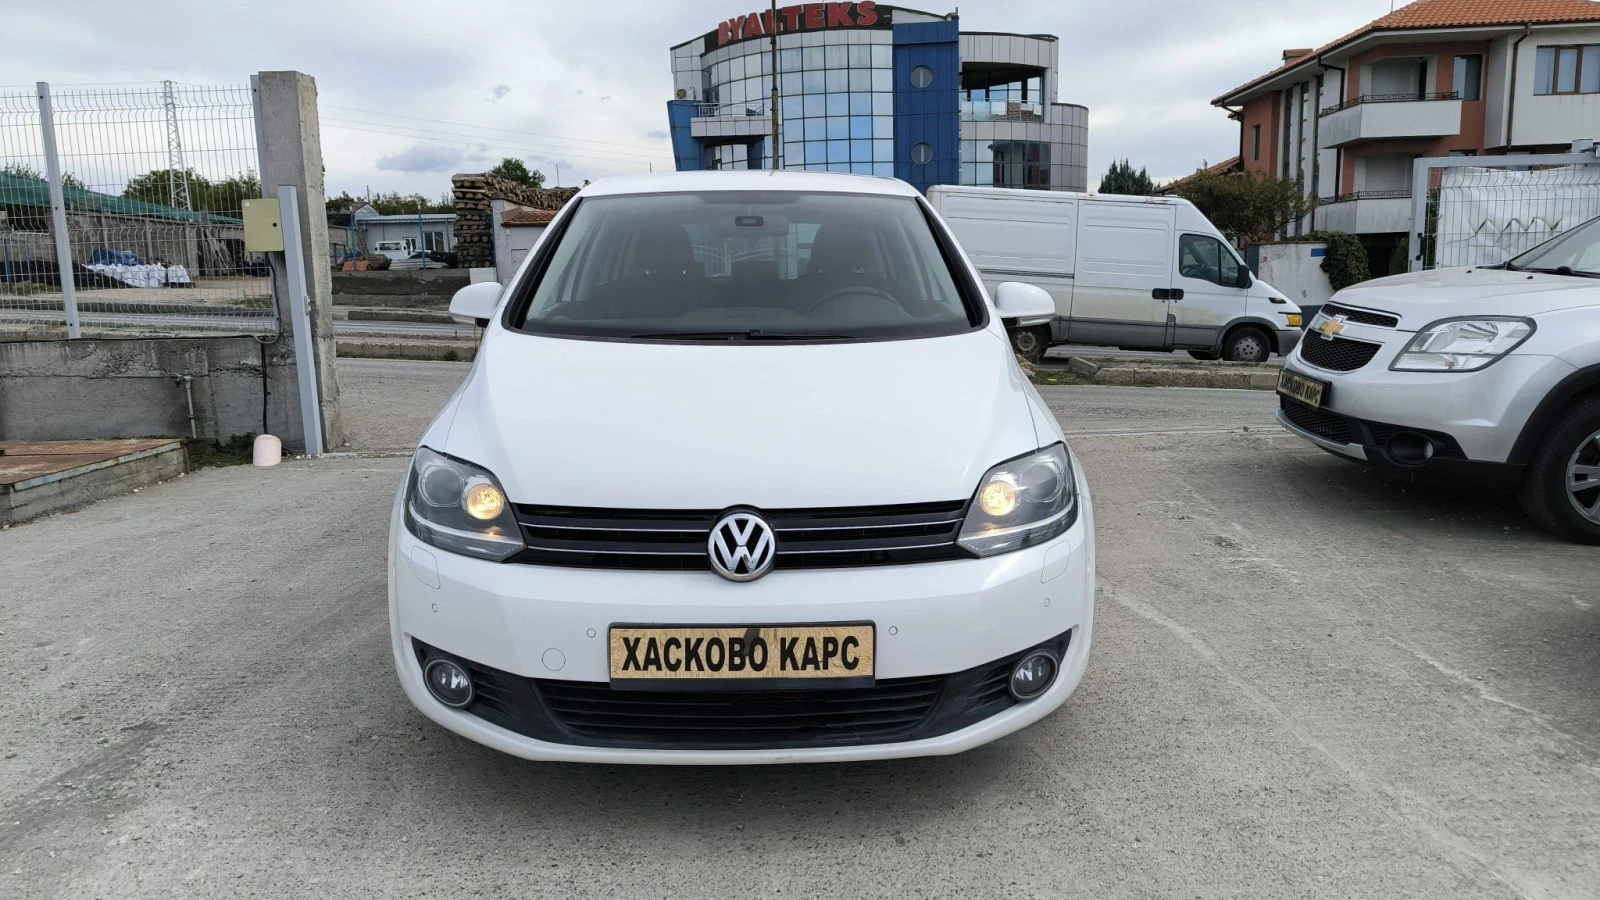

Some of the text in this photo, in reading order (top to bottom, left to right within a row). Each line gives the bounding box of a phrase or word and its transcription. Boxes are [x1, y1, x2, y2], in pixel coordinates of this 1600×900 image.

[718, 0, 878, 46] BYALTEKS
[710, 513, 773, 579] VW
[622, 636, 860, 672] ХАСКОВО КАРС
